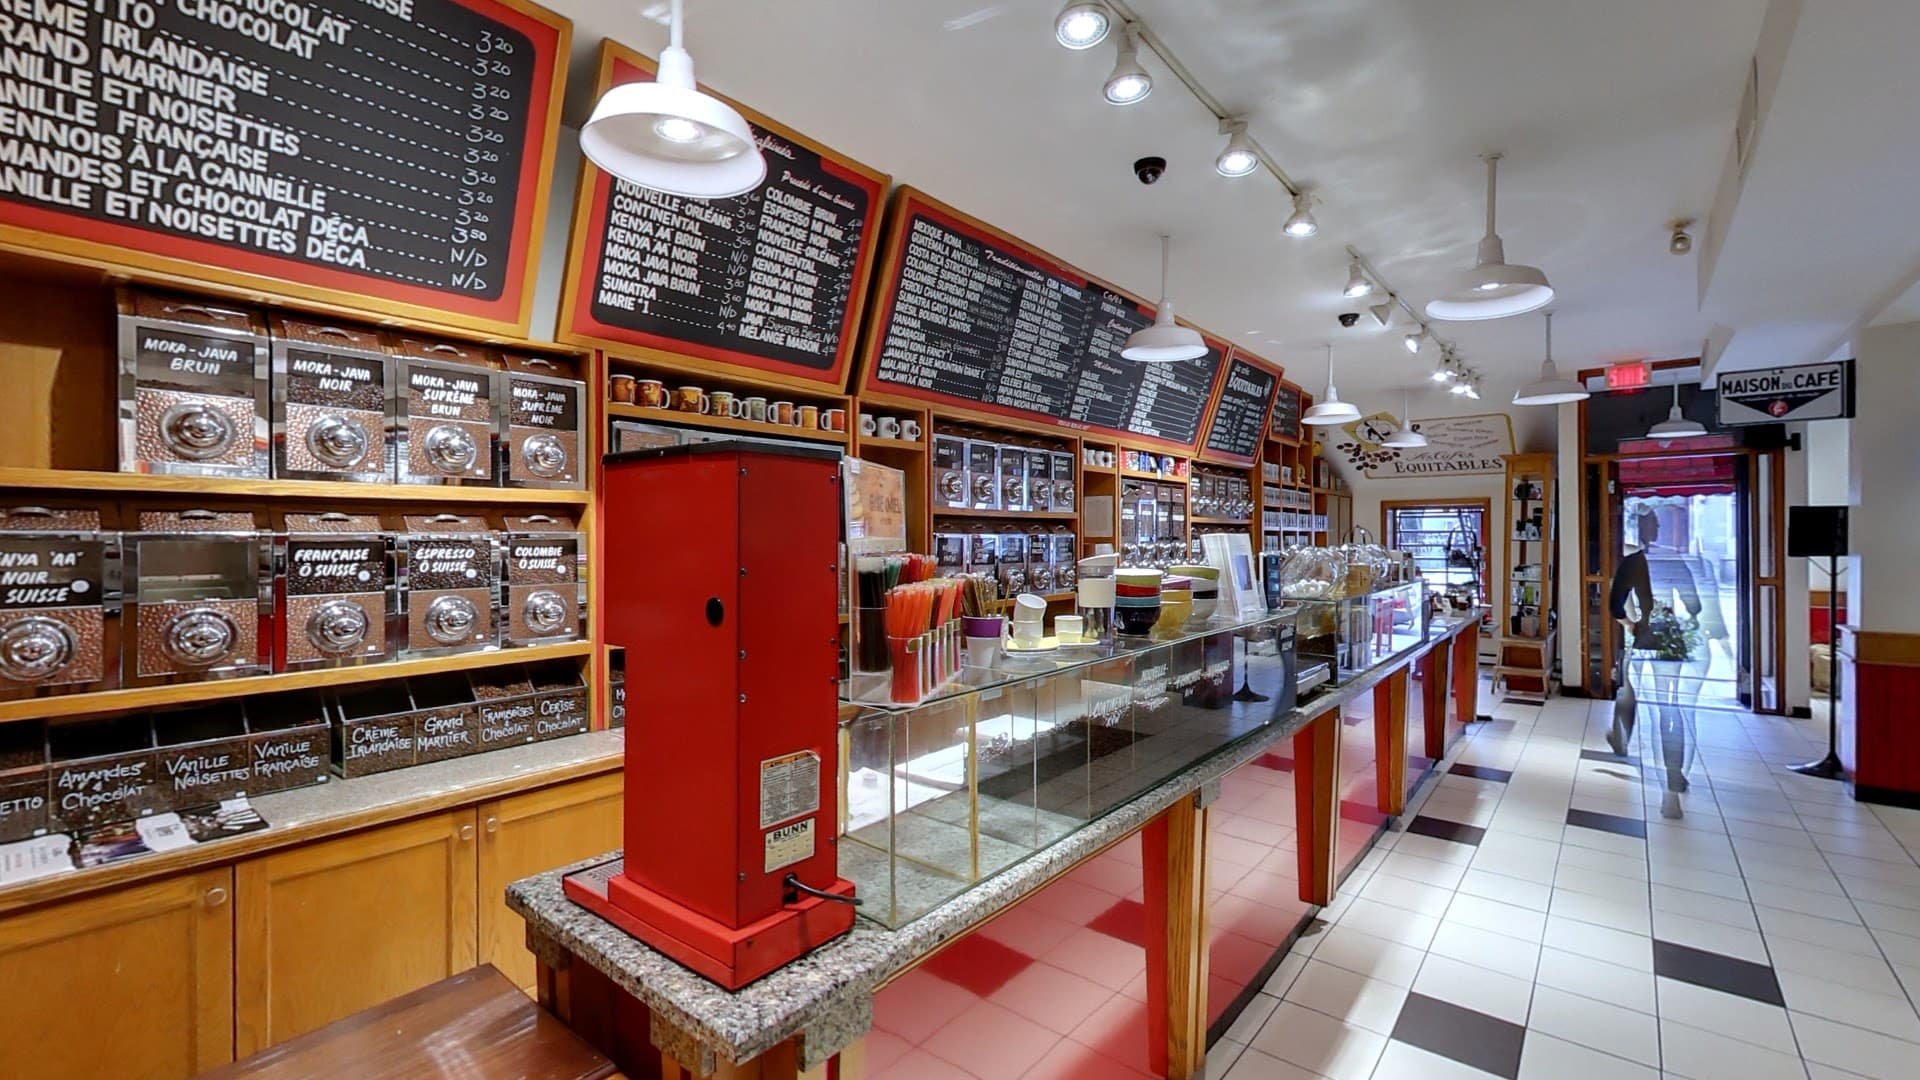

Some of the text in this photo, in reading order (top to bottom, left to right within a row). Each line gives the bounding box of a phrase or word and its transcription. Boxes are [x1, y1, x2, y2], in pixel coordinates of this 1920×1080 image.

[102, 19, 269, 97] IRLANDAISE
[100, 47, 237, 112] MARNIER
[102, 77, 143, 109] ET
[148, 91, 300, 156] NOISETTES
[117, 110, 268, 173] FRANÇAISE
[127, 137, 152, 168] À
[157, 150, 195, 180] LA
[200, 161, 326, 213] CANNELLE
[613, 194, 702, 236] CONTINENTAL
[762, 200, 810, 228] ESPRESSO
[765, 186, 813, 215] COLOMBIE
[813, 206, 837, 224] BRUN
[130, 170, 167, 199] ET
[175, 182, 304, 231] CHOCOLAT
[309, 214, 370, 247] DÉCA
[451, 247, 487, 267] N/D
[105, 190, 144, 220] ET
[148, 202, 296, 254] NOISETTES
[306, 235, 367, 270] DÉCA
[451, 272, 487, 290] N/D
[610, 210, 653, 237] KENYA
[674, 232, 706, 252] BRUN
[608, 226, 651, 252] KENYA
[671, 248, 699, 265] NOIR
[605, 242, 641, 264] MOKA
[642, 253, 669, 273] JAVA
[671, 262, 699, 280] NOIR
[755, 242, 817, 273] CONTINENTAL
[602, 275, 657, 300] SUMATRA
[603, 258, 640, 281] MOKA
[643, 270, 669, 288] JAVA
[669, 278, 700, 297] BRUN
[598, 290, 635, 311] MARIE
[747, 283, 773, 301] MOKA
[744, 297, 770, 314] MOKA
[170, 357, 221, 376] BRUN
[319, 377, 352, 392] NOIR
[1721, 376, 1780, 396] MAISON
[1793, 368, 1840, 389] CAFÉ
[431, 403, 461, 417] BRUN
[531, 414, 555, 425] NOIR
[0, 551, 39, 568] NYA
[294, 548, 370, 564] FRANÇAISE
[415, 548, 476, 561] ESPRESSO
[514, 546, 563, 558] COLOMBIE
[314, 562, 359, 578] SUISSE
[431, 560, 467, 573] SUISSE
[527, 558, 557, 570] SUISSE
[1, 571, 49, 586] NOIR
[4, 587, 70, 604] SUISSE
[774, 822, 808, 840] BUNN
